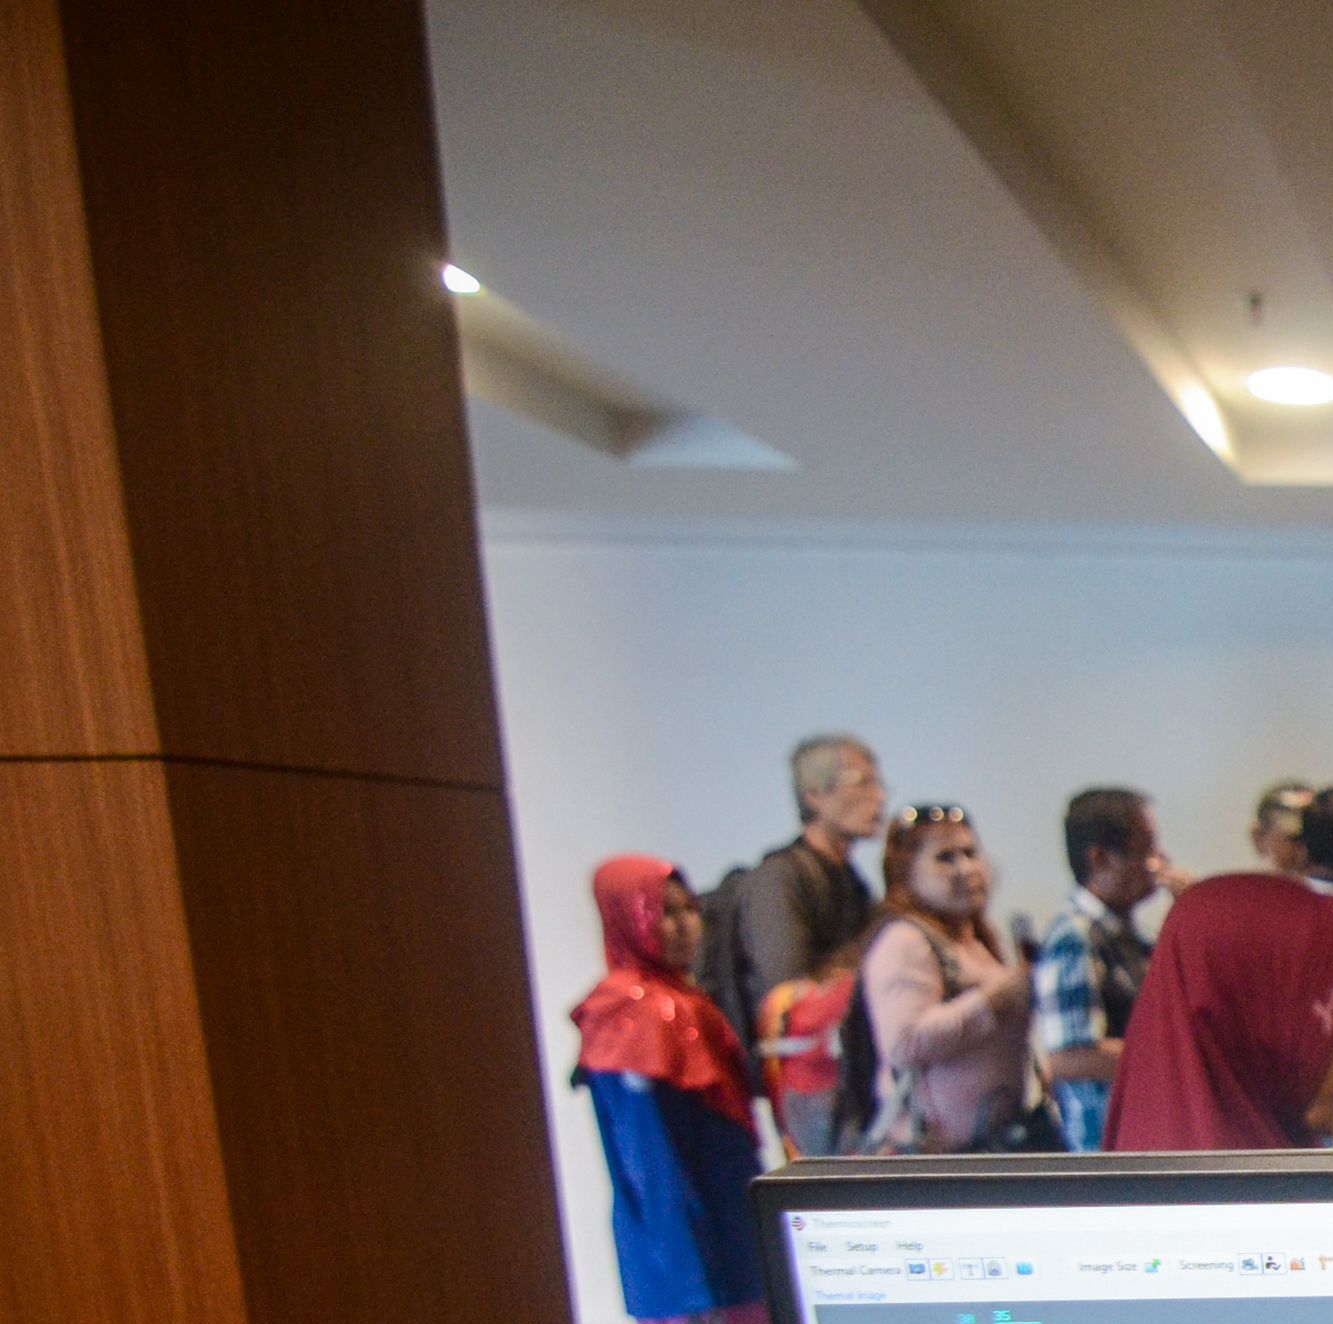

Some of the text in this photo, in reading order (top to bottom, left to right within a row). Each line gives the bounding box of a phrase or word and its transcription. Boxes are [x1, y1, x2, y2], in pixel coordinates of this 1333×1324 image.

[807, 1240, 924, 1254] File Setup Help
[810, 1264, 902, 1277] Thermal Camera
[1079, 1259, 1139, 1275] Image Size
[1180, 1258, 1234, 1273] Screening
[857, 1290, 888, 1302] Image
[993, 1310, 1012, 1322] 35
